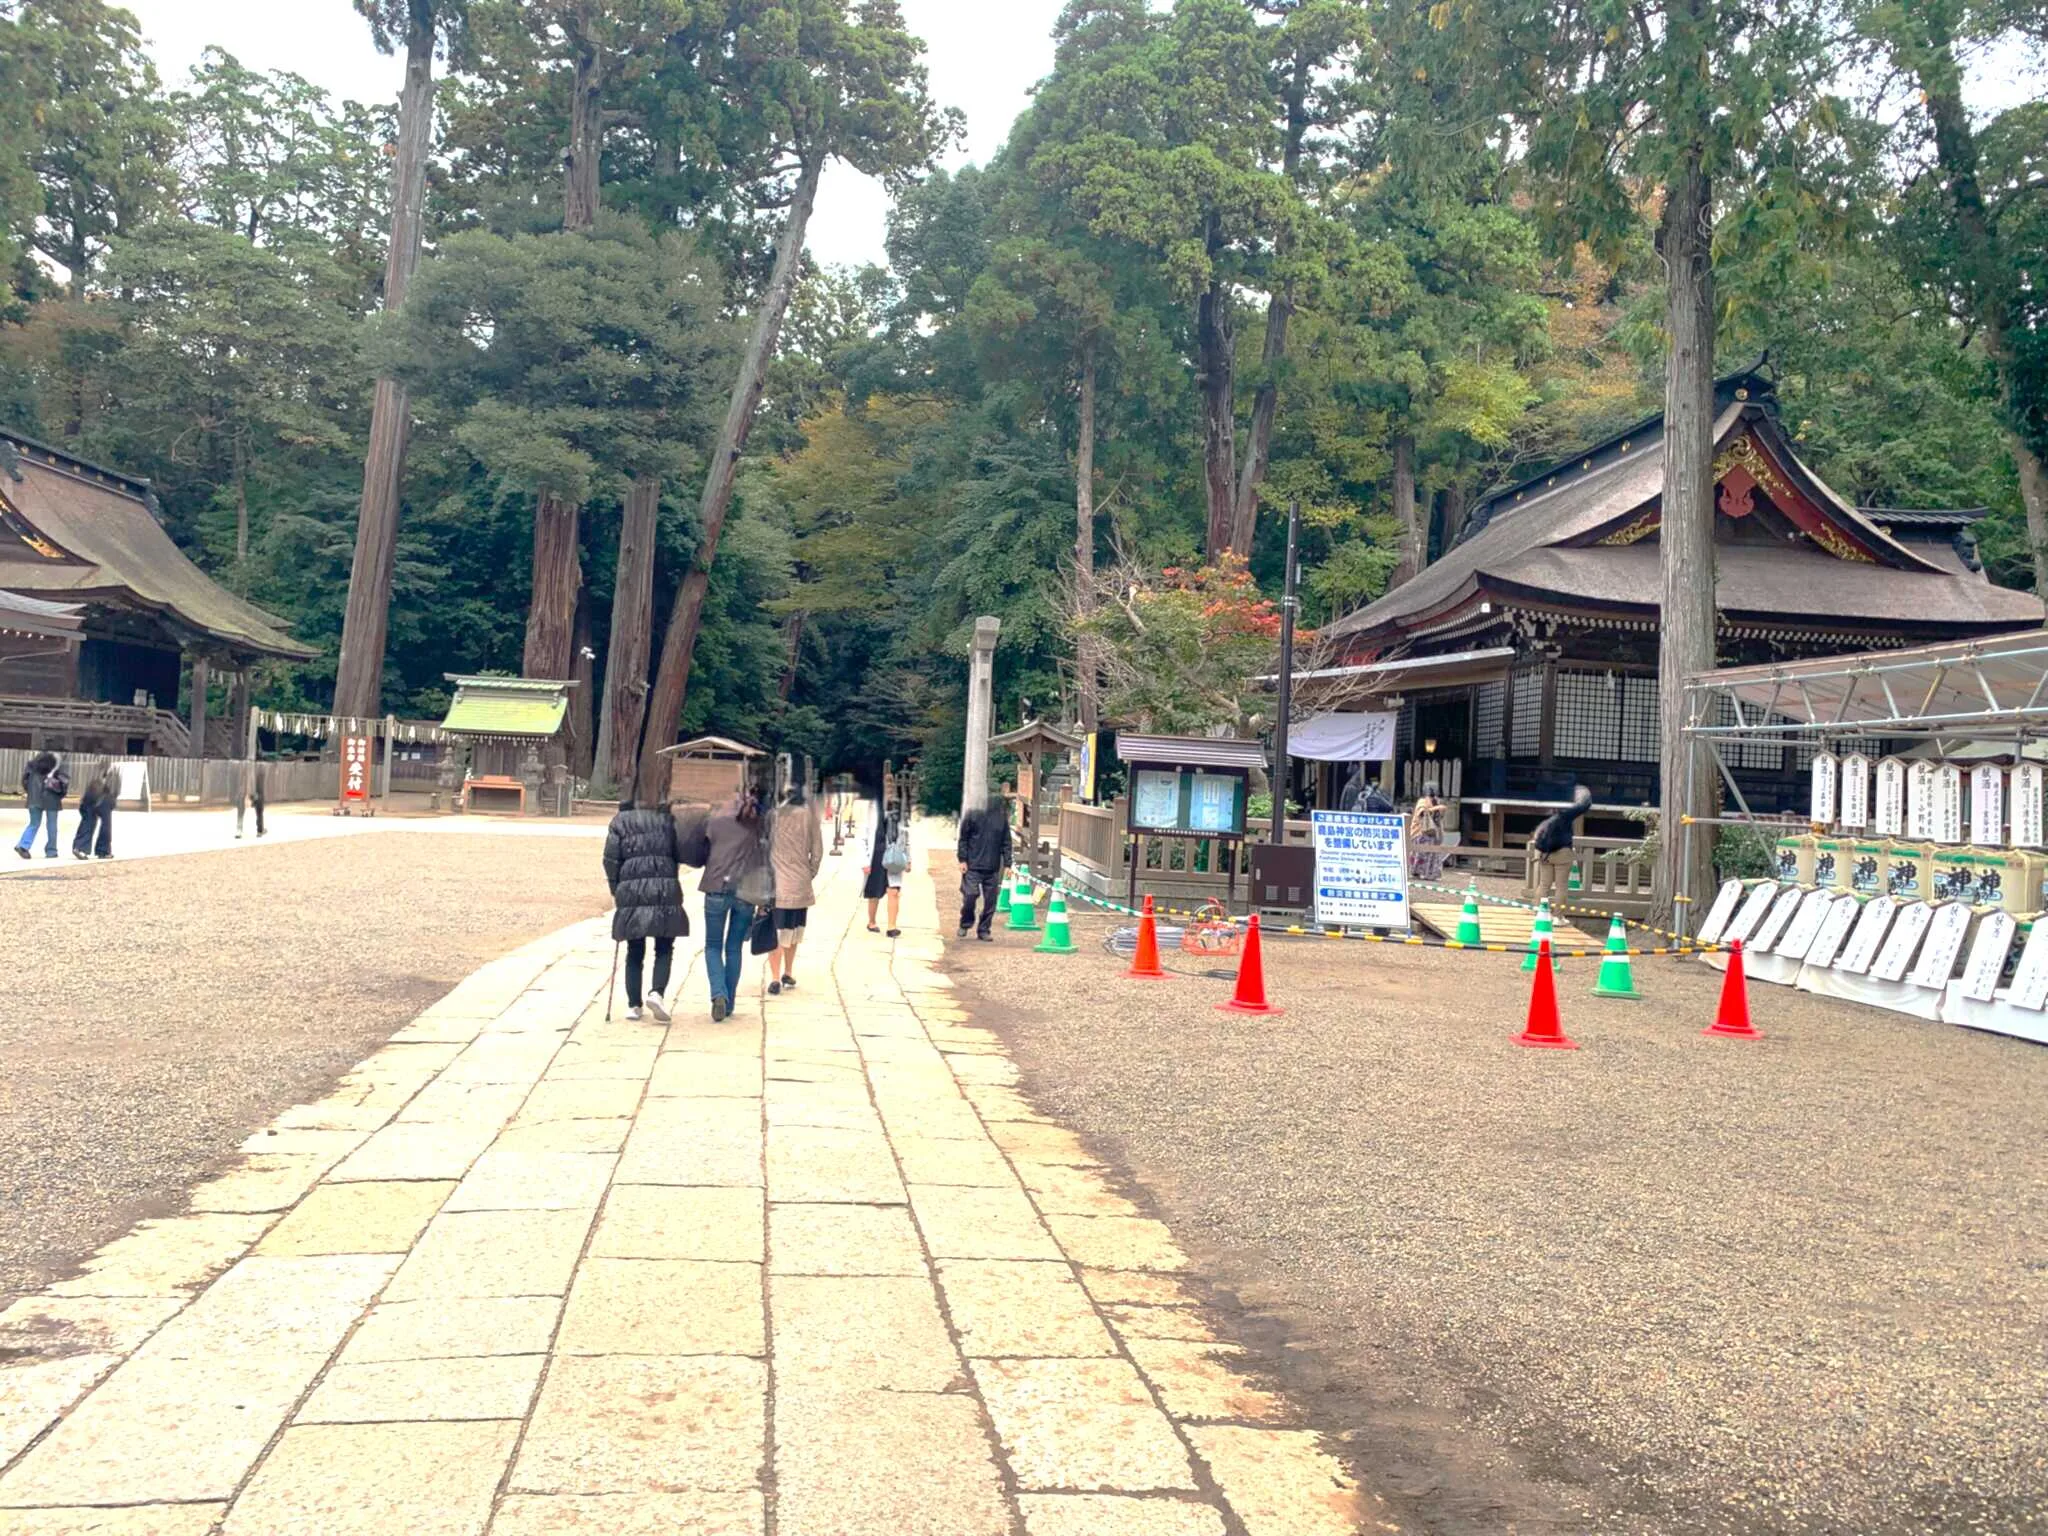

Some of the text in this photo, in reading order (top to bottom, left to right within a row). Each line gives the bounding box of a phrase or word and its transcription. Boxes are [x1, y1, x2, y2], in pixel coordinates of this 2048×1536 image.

[1981, 767, 1991, 789] 献酒
[2021, 766, 2032, 789] 献酒
[1318, 825, 1400, 840] 鹿島神宮の防災設備
[1324, 837, 1395, 851] を整備しています
